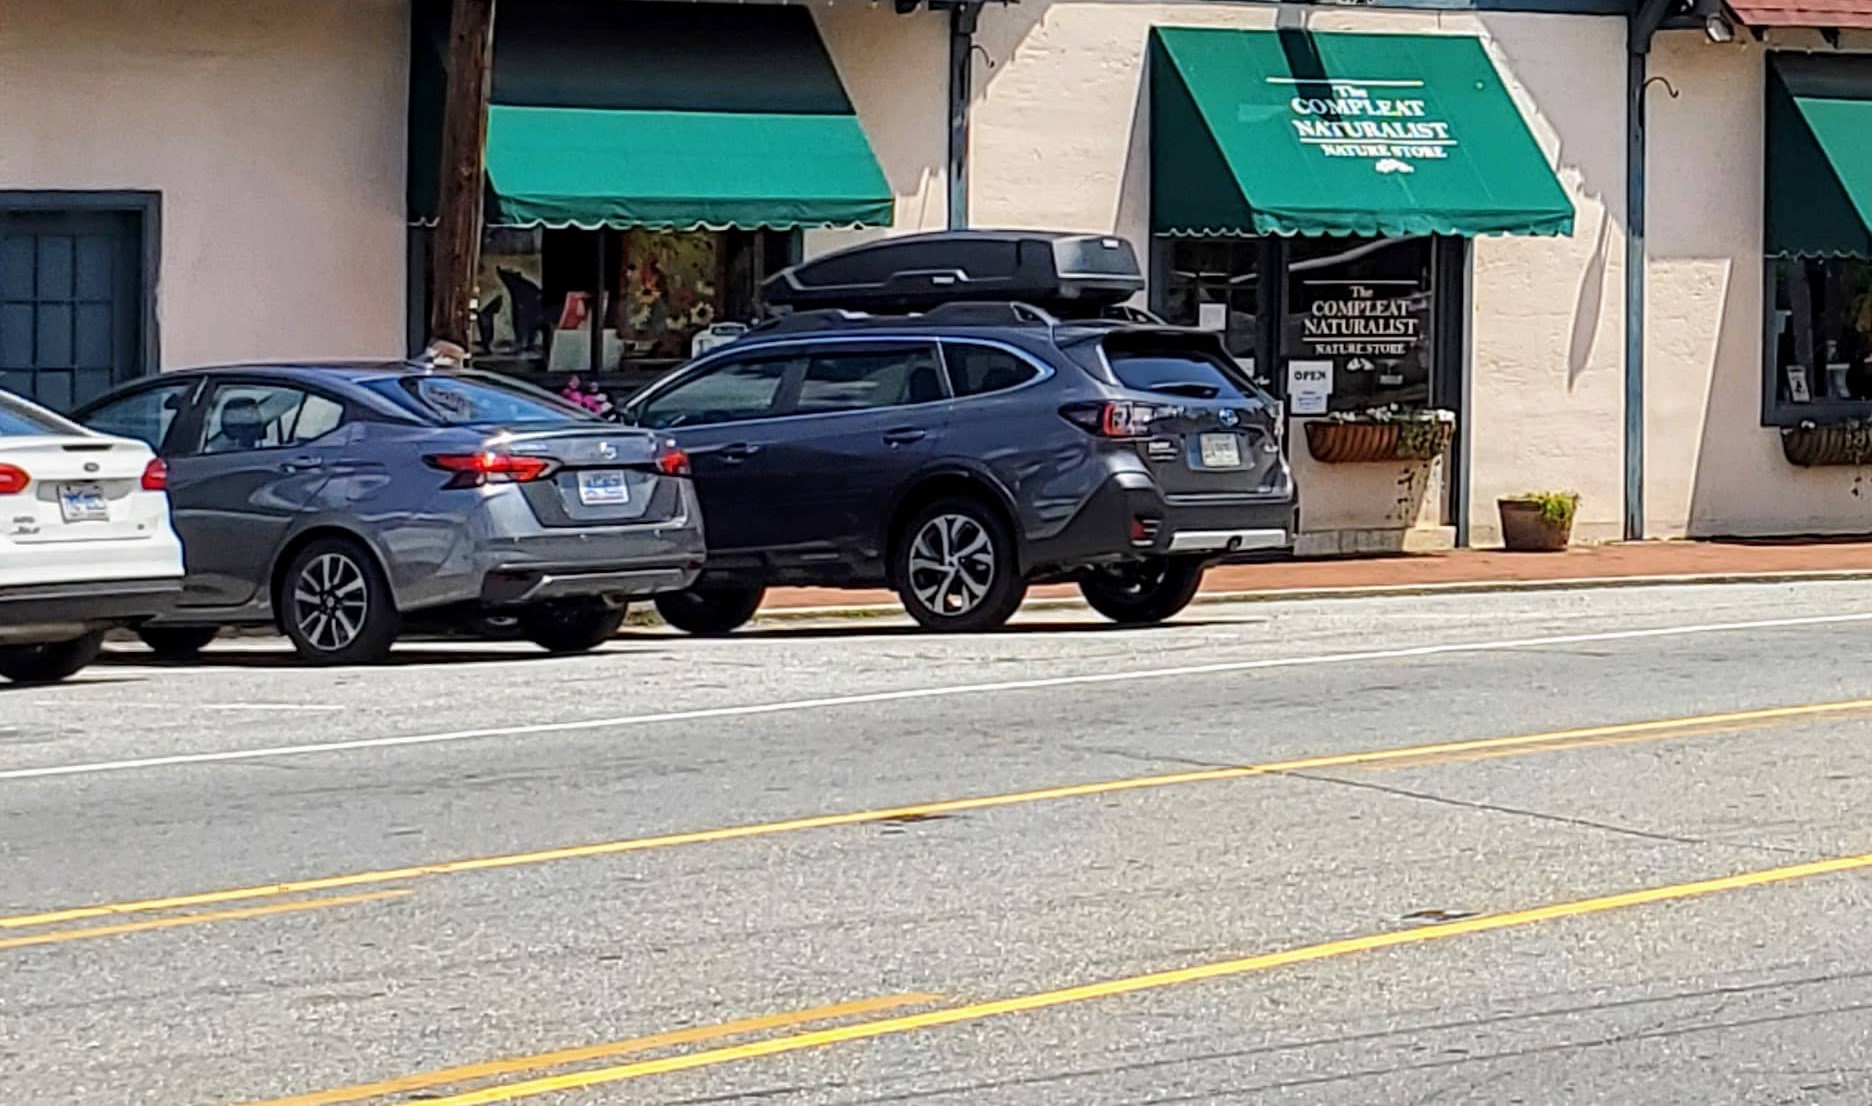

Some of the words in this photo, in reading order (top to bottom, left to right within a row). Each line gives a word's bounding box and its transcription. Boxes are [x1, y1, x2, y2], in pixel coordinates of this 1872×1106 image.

[1332, 85, 1368, 98] The
[1290, 98, 1425, 116] COMPLEAT
[1291, 120, 1449, 139] NATURALIST
[1320, 144, 1390, 157] NATURE
[1391, 145, 1448, 158] STORE
[1349, 285, 1374, 298] The
[1312, 300, 1411, 316] COMPLEAT
[1303, 318, 1419, 335] NATURALIST
[1315, 343, 1363, 355] NATURE
[1365, 343, 1406, 355] STORE
[1294, 371, 1326, 381] OPEN
